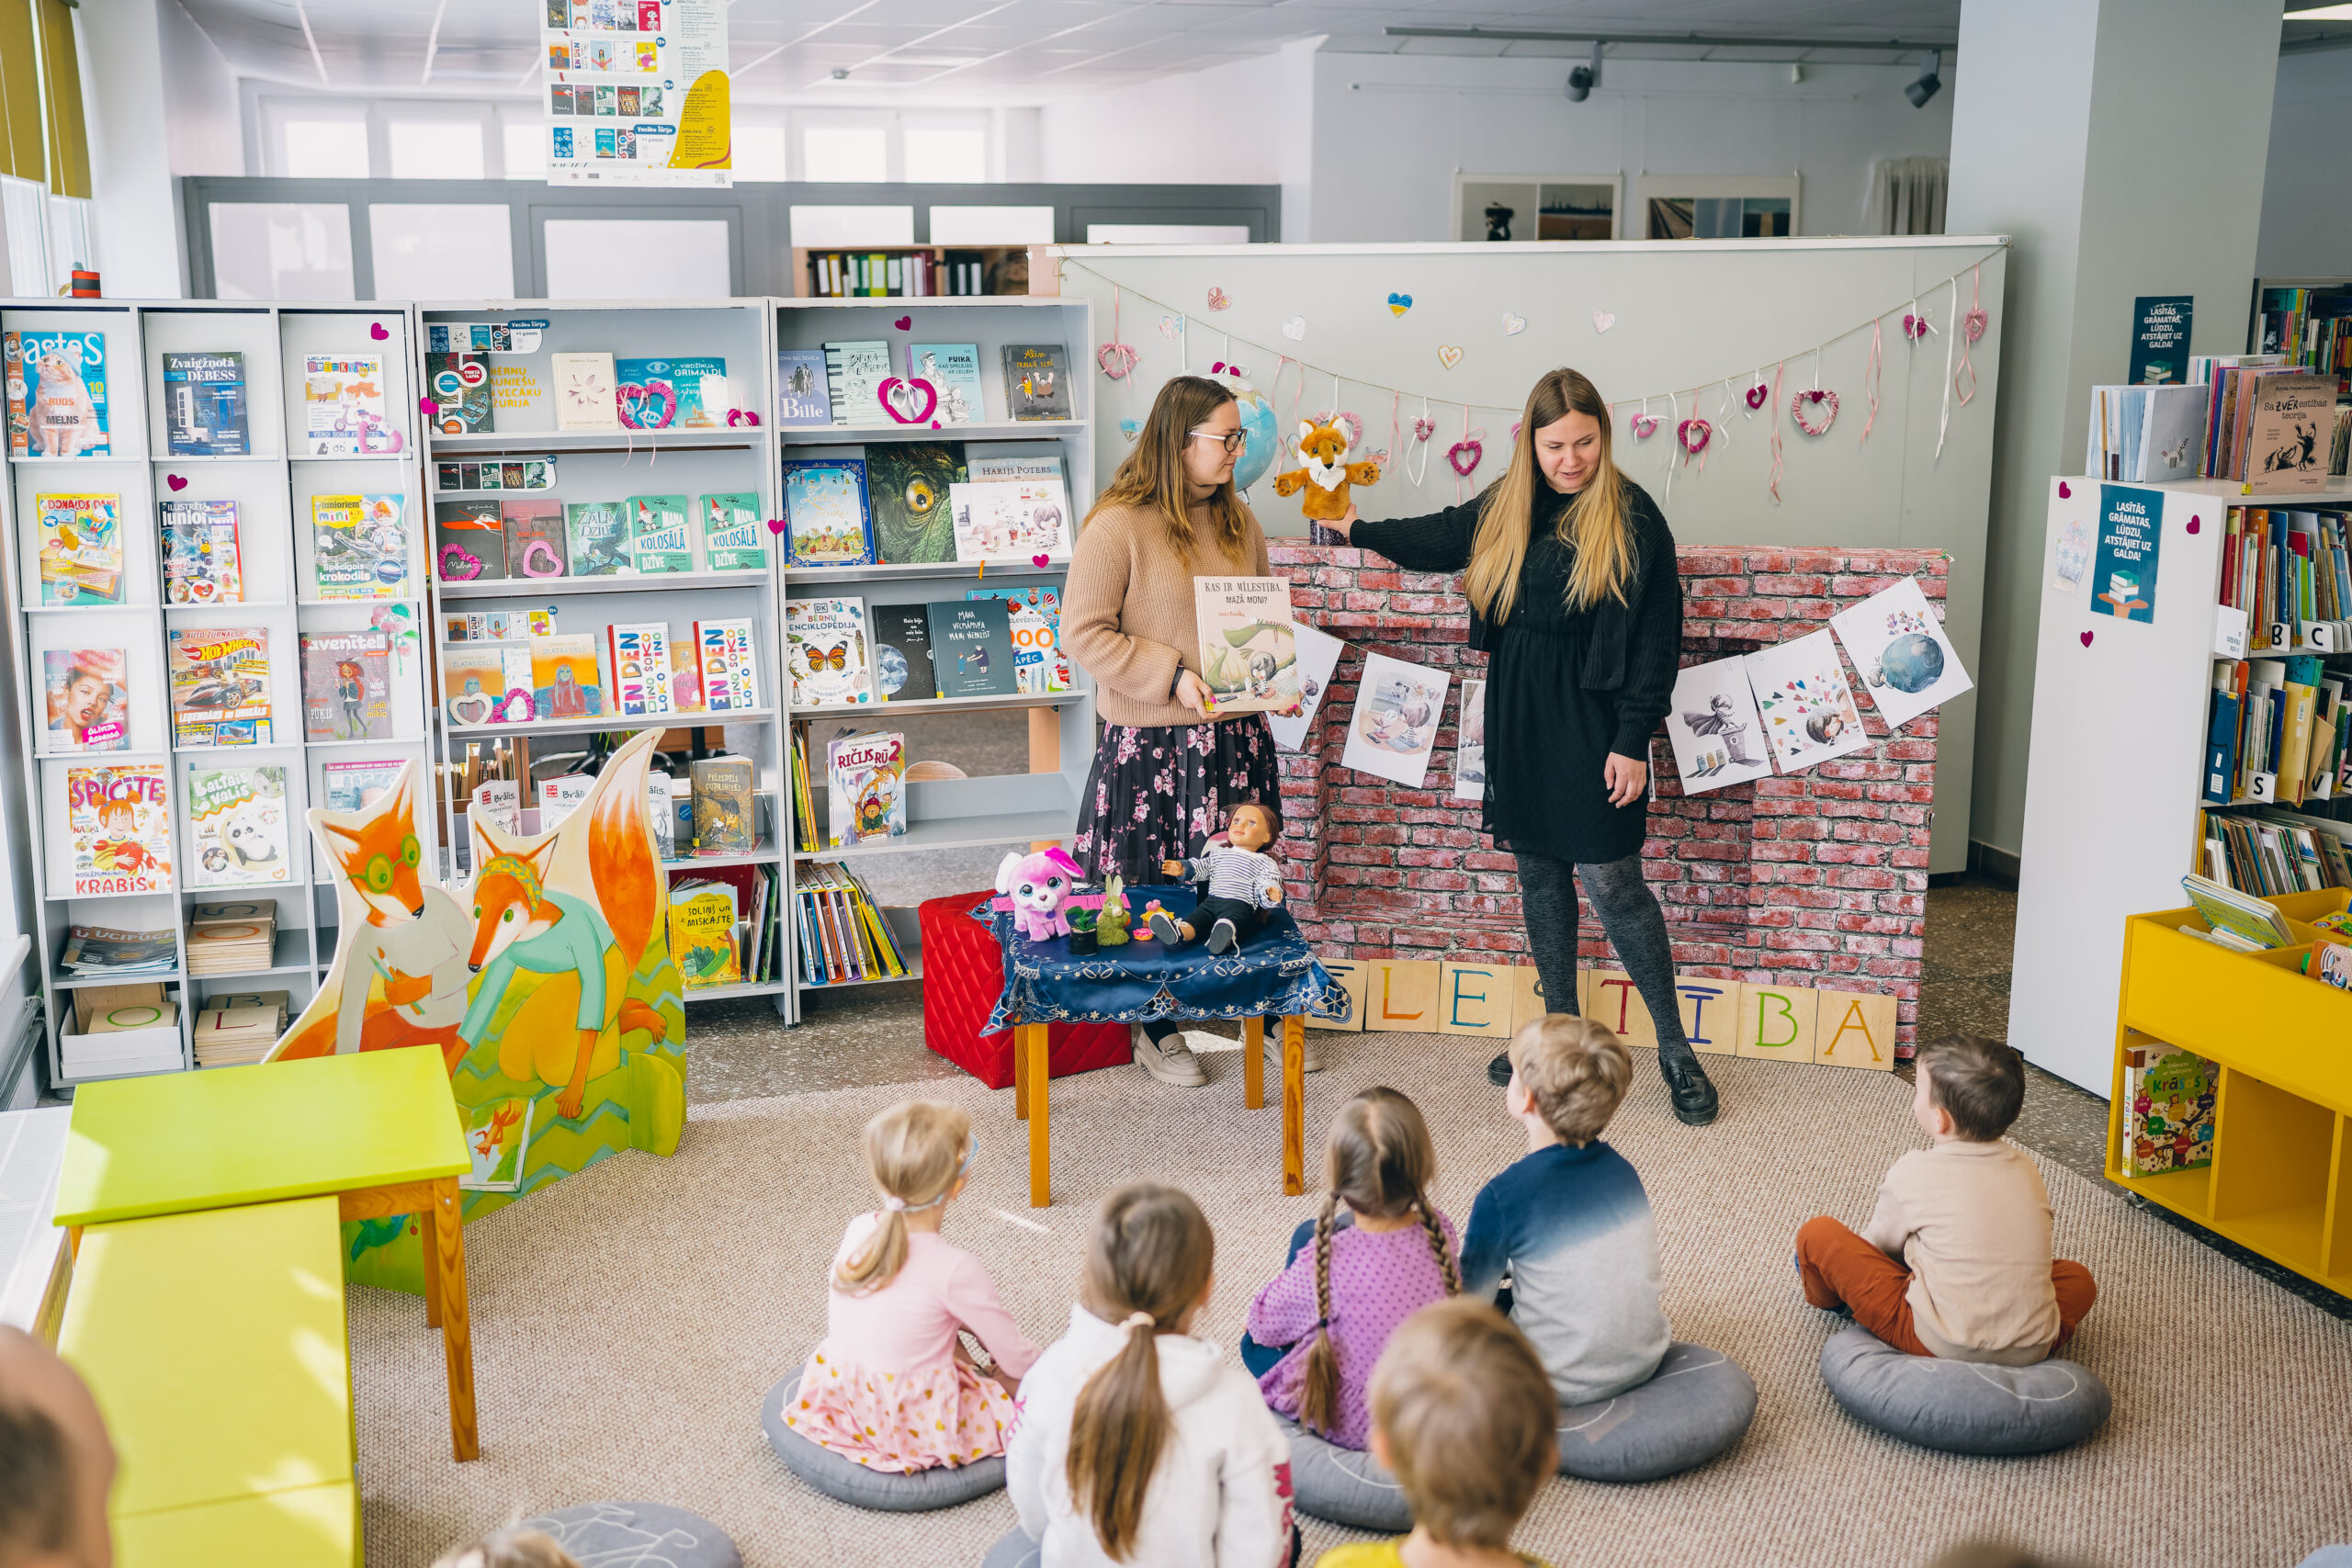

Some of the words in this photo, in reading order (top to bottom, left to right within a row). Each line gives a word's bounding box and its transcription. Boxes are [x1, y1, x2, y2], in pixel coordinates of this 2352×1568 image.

[2150, 307, 2177, 316] LASĪTĀS
[2141, 333, 2174, 341] ATSTĀJIET
[2150, 323, 2174, 333] LŪDZU,
[88, 381, 104, 393] 10
[497, 387, 541, 397] VECĀKU
[780, 398, 824, 419] Bille
[2281, 412, 2308, 420] teorija
[46, 416, 79, 424] MELNS
[982, 467, 1014, 476] HARIJS
[1017, 466, 1052, 474] POTERS
[318, 510, 349, 523] mini
[734, 508, 756, 525] MANA
[2116, 502, 2146, 514] LASĪTĀS
[662, 510, 684, 528] MANA
[2109, 512, 2151, 530] GRĀMATAS,
[640, 527, 685, 550] KOLOSĀLĀ
[713, 525, 758, 547] KOLOSĀLĀ
[2115, 524, 2143, 539] LŪDZU,
[2104, 535, 2142, 550] ATSTĀJIET
[2141, 539, 2152, 551] UZ
[642, 554, 665, 570] DZĪVE
[715, 551, 738, 568] DZĪVE
[2113, 547, 2142, 562] GALDA!
[1204, 581, 1221, 592] KAS
[1223, 582, 1233, 592] IR
[1226, 594, 1245, 604] MAZĀ
[1247, 596, 1268, 604] MONI?
[788, 621, 857, 631] ENCIKLOPĒDIJA
[2271, 625, 2284, 646] B
[2312, 626, 2324, 647] C
[641, 633, 653, 671] SOKO
[652, 632, 664, 668] TINO
[704, 629, 727, 675] DEN
[726, 629, 738, 668] SOKO
[737, 628, 749, 663] TINO
[619, 633, 642, 678] DEN
[646, 677, 658, 714] DINO
[656, 672, 669, 713] LOKO
[708, 680, 731, 711] EN
[730, 672, 742, 709] DINO
[741, 669, 753, 707] LOKO
[624, 684, 647, 716] EN
[888, 740, 901, 762] 2
[2253, 776, 2265, 795] S
